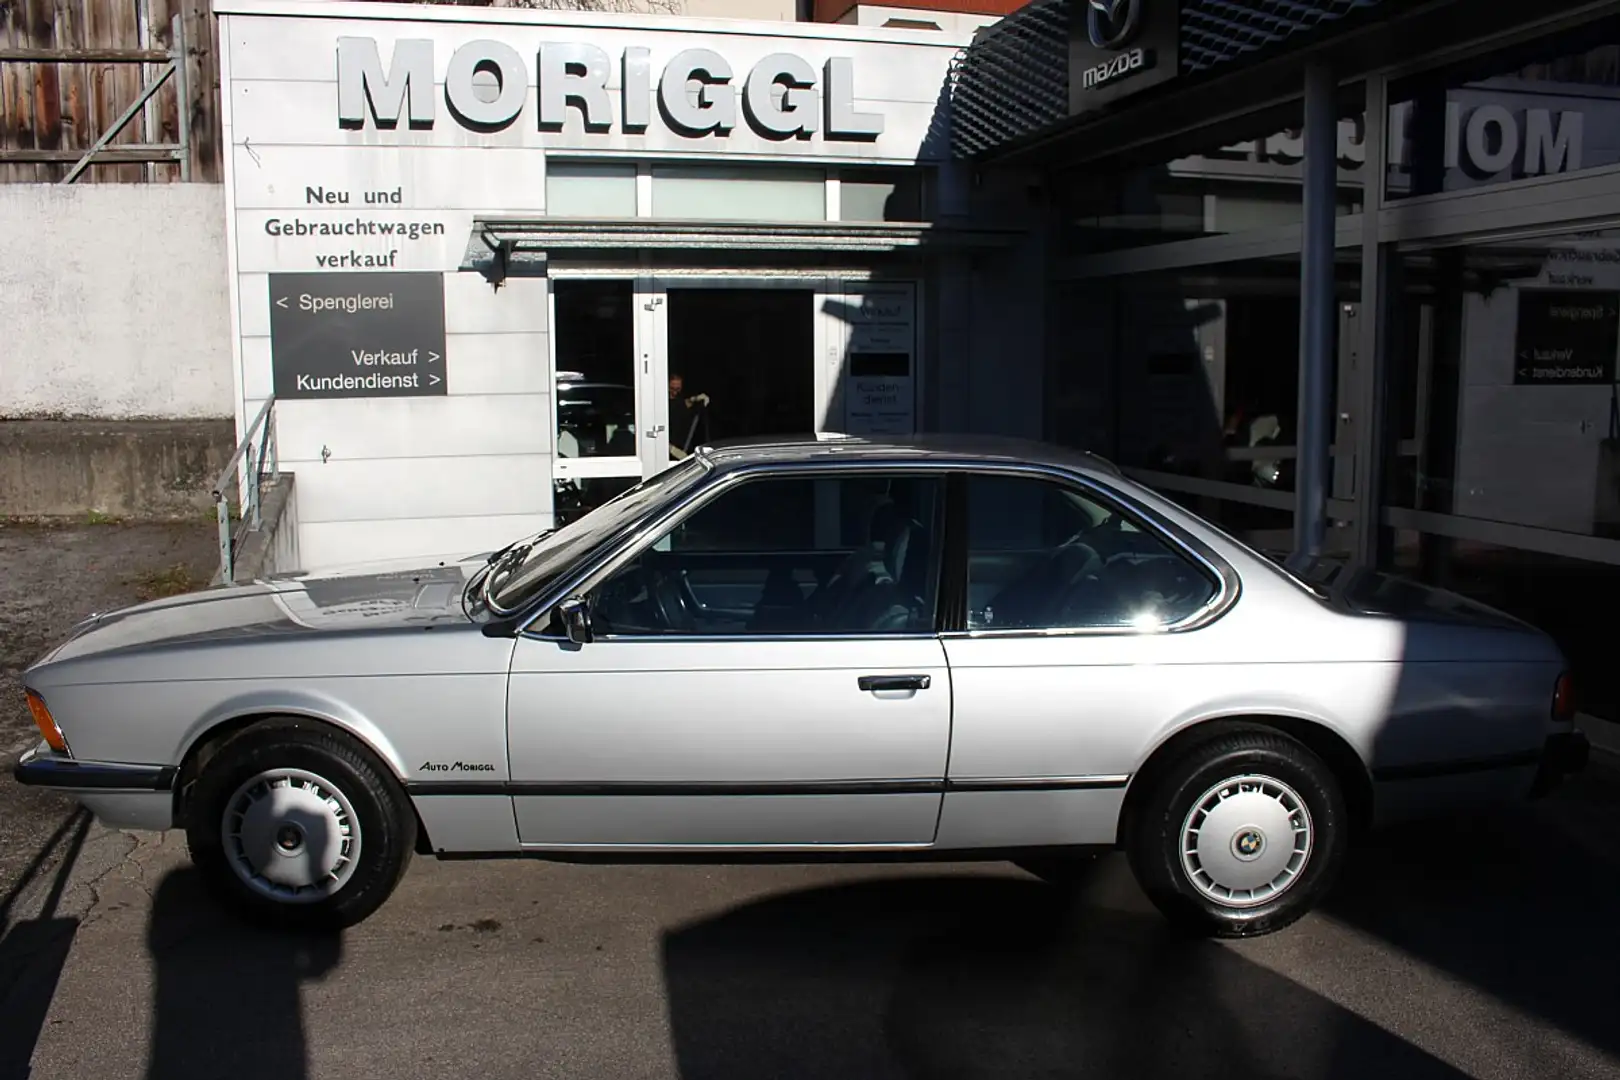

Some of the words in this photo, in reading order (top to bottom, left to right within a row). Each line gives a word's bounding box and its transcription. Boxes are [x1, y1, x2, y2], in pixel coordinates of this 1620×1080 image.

[337, 36, 885, 142] MORIGGL
[306, 186, 349, 204] Neu
[364, 186, 402, 204] und
[264, 218, 446, 240] Gebrauchtwagen
[316, 249, 398, 267] verkauf
[299, 293, 394, 313] Spenglerei
[351, 349, 418, 366] Verkauf
[297, 373, 419, 390] Kundendienst
